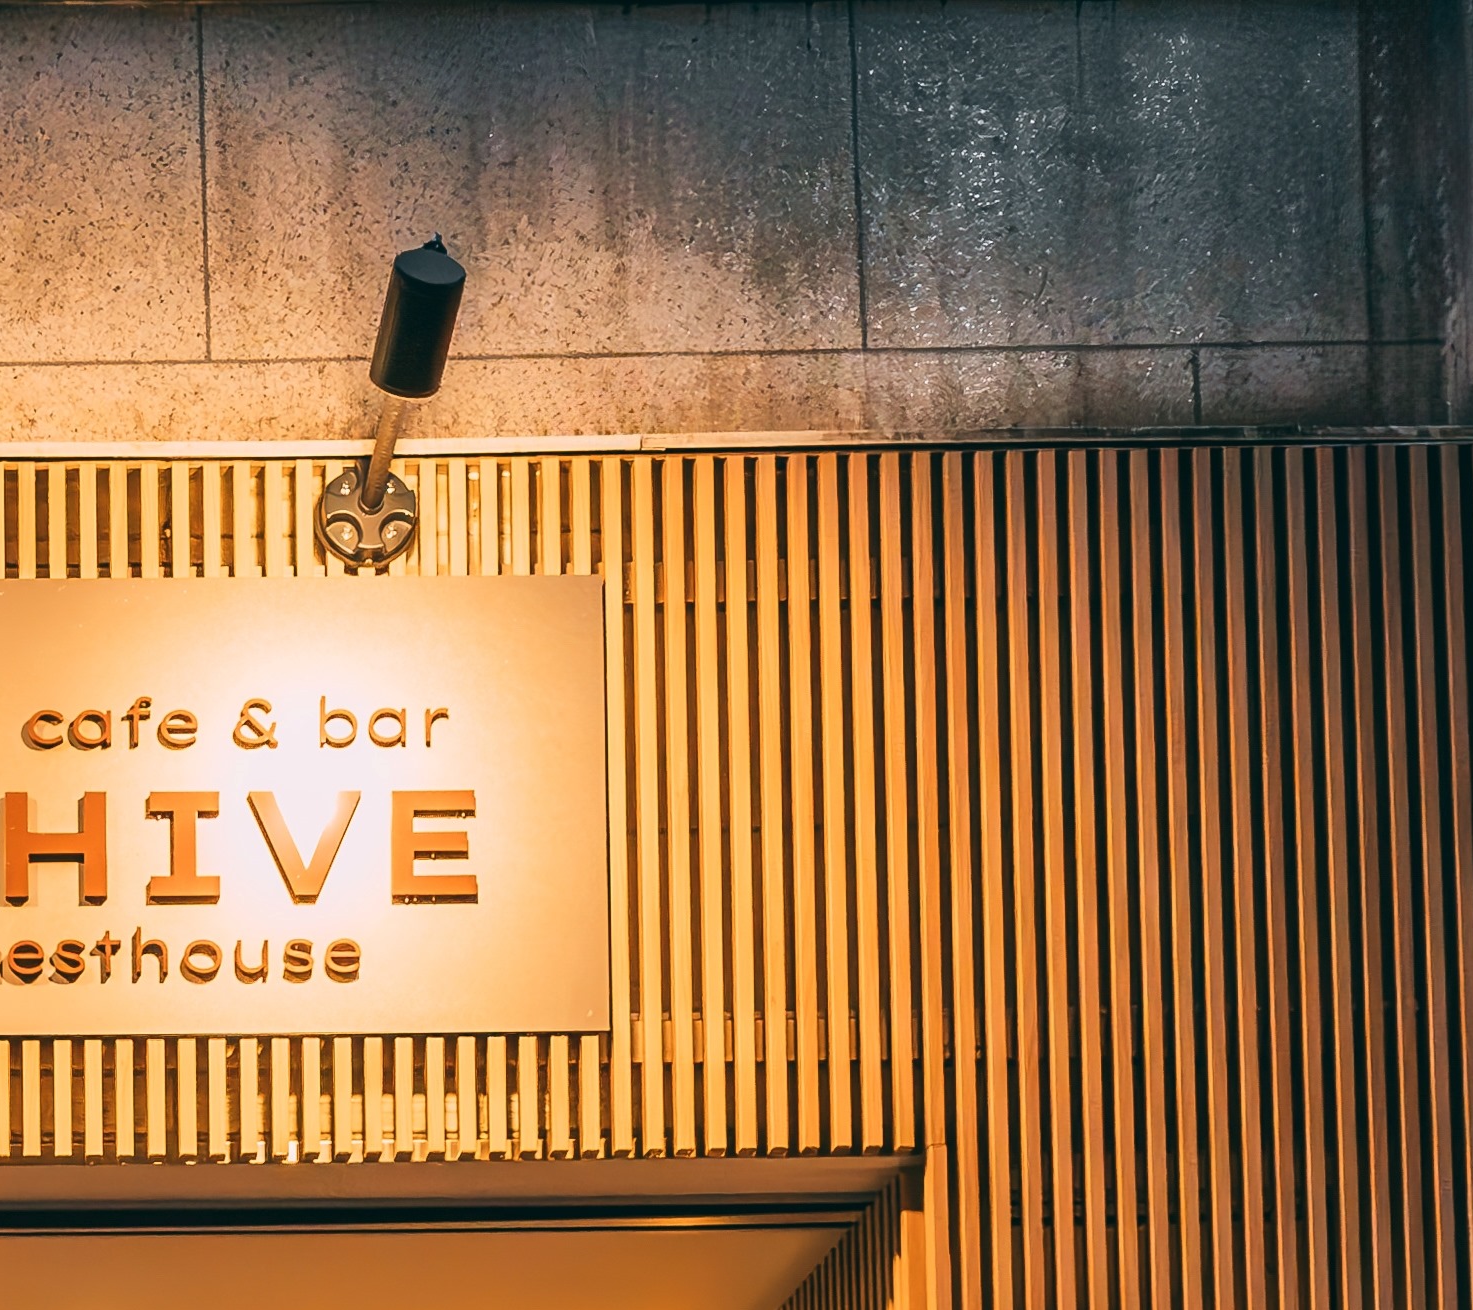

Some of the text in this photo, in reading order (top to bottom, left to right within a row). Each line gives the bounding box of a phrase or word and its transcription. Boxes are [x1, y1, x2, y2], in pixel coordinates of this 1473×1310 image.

[24, 696, 449, 750] cafe & bar
[3, 790, 479, 906] HIVE
